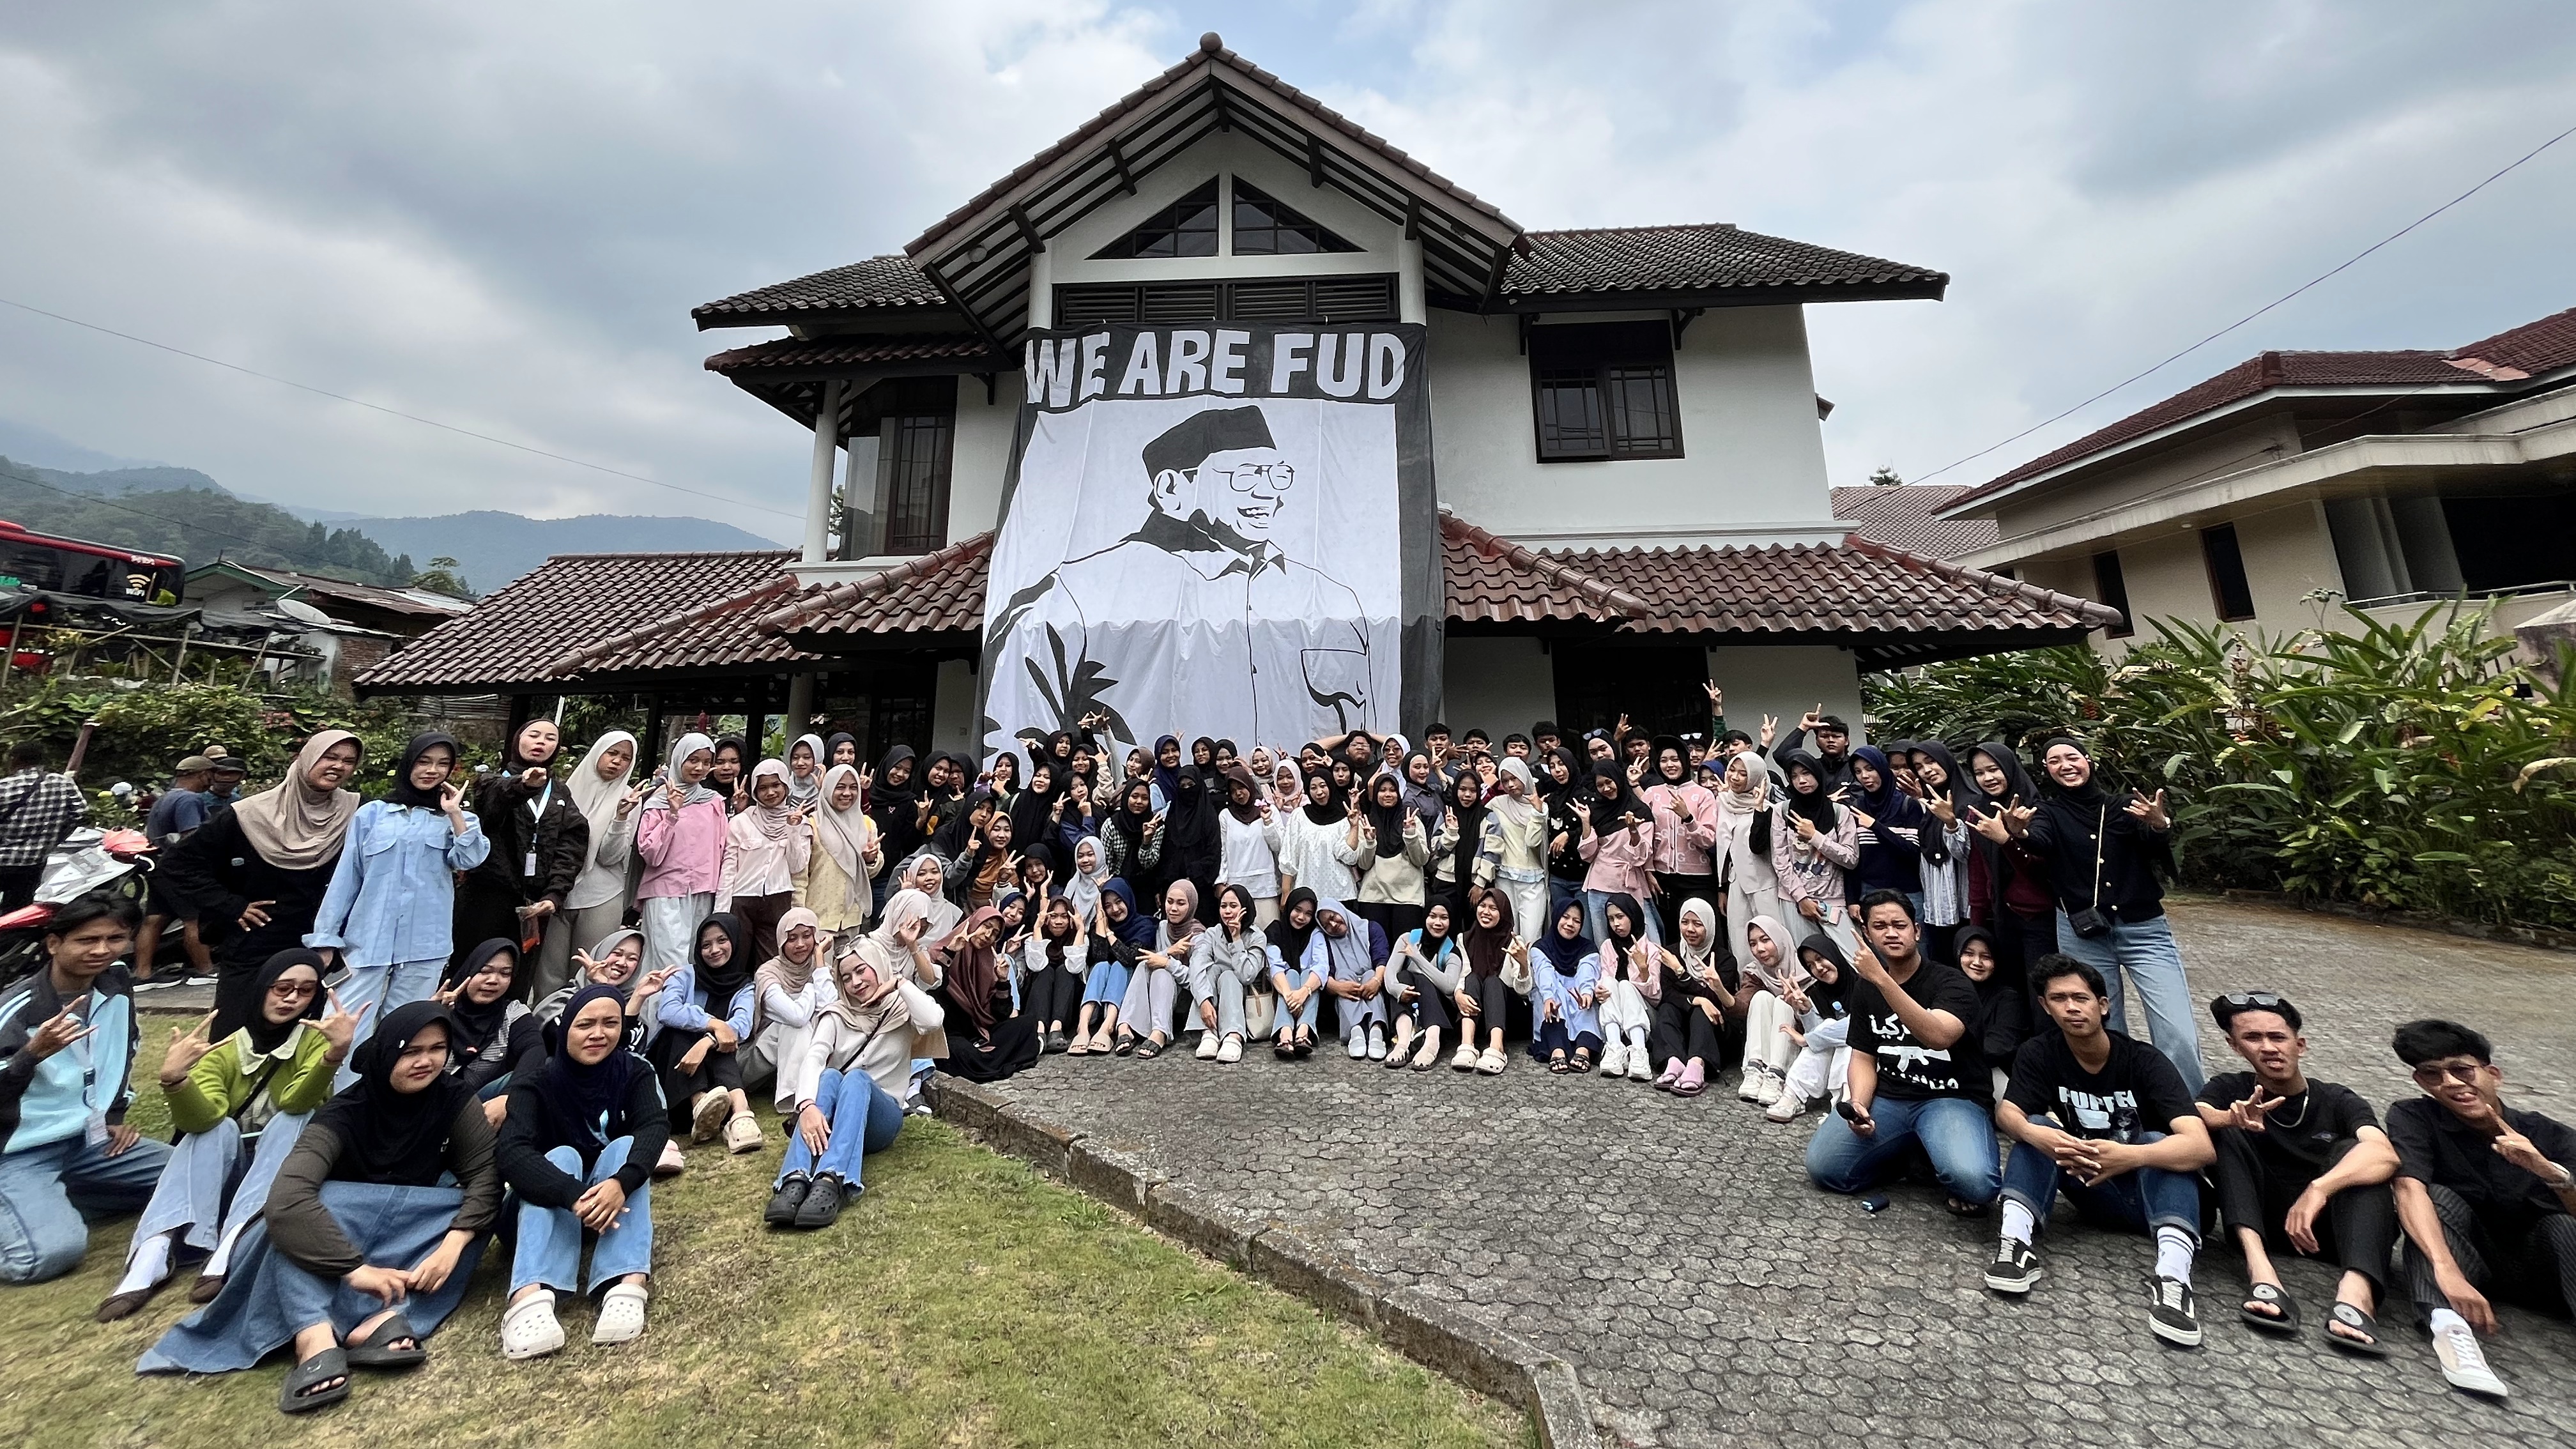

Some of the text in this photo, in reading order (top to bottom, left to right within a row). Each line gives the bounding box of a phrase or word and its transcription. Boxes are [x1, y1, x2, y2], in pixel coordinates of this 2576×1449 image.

[1025, 329, 1406, 408] WE ARE FUD
[1678, 852, 1685, 862] G
